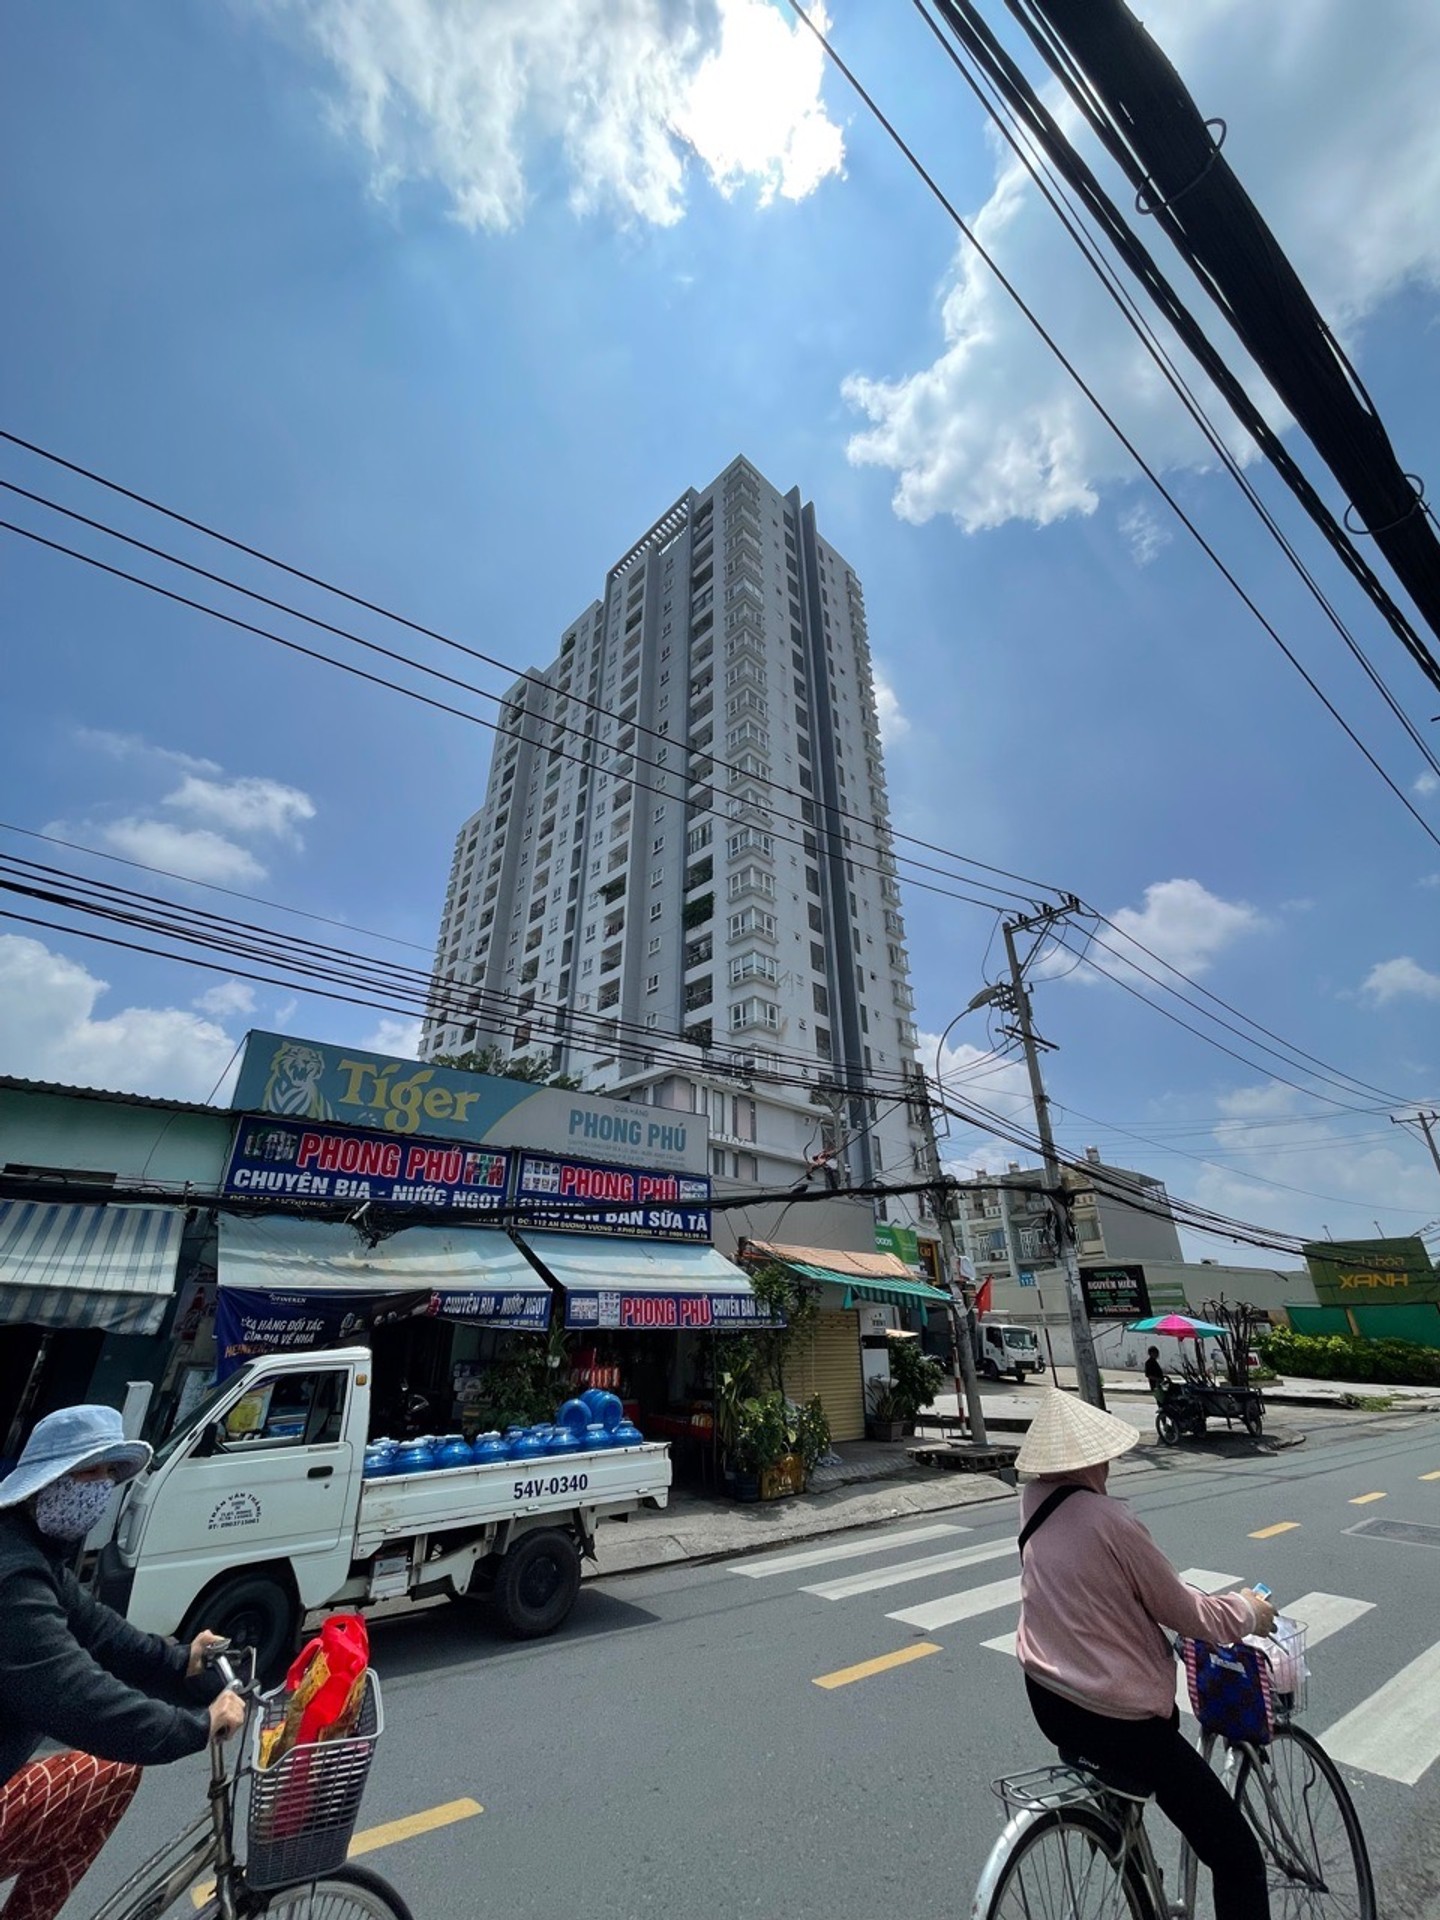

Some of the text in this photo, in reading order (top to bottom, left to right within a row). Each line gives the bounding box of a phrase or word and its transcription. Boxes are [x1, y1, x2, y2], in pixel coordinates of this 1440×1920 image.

[337, 1058, 481, 1134] Tiger
[568, 1109, 642, 1146] PHONG
[647, 1122, 687, 1152] PHÚ
[296, 1132, 463, 1185] PHONG PHÚ
[232, 1168, 329, 1196] CHUYÊN
[333, 1179, 371, 1200] BIA
[391, 1184, 447, 1206] NƯỚC
[559, 1166, 634, 1202] PHONG
[648, 1208, 684, 1230] SỮA
[687, 1212, 708, 1232] TÃ
[1338, 1272, 1409, 1289] XANH
[443, 1292, 480, 1315] CHUYÊN
[480, 1296, 495, 1316] BIA
[621, 1297, 677, 1326] PHONG
[679, 1293, 712, 1326] PHÚ
[712, 1295, 740, 1317] CHUYÊN
[256, 1316, 287, 1331] HÀNG
[304, 1317, 325, 1331] TÁC
[513, 1473, 588, 1500] 54V-0340
